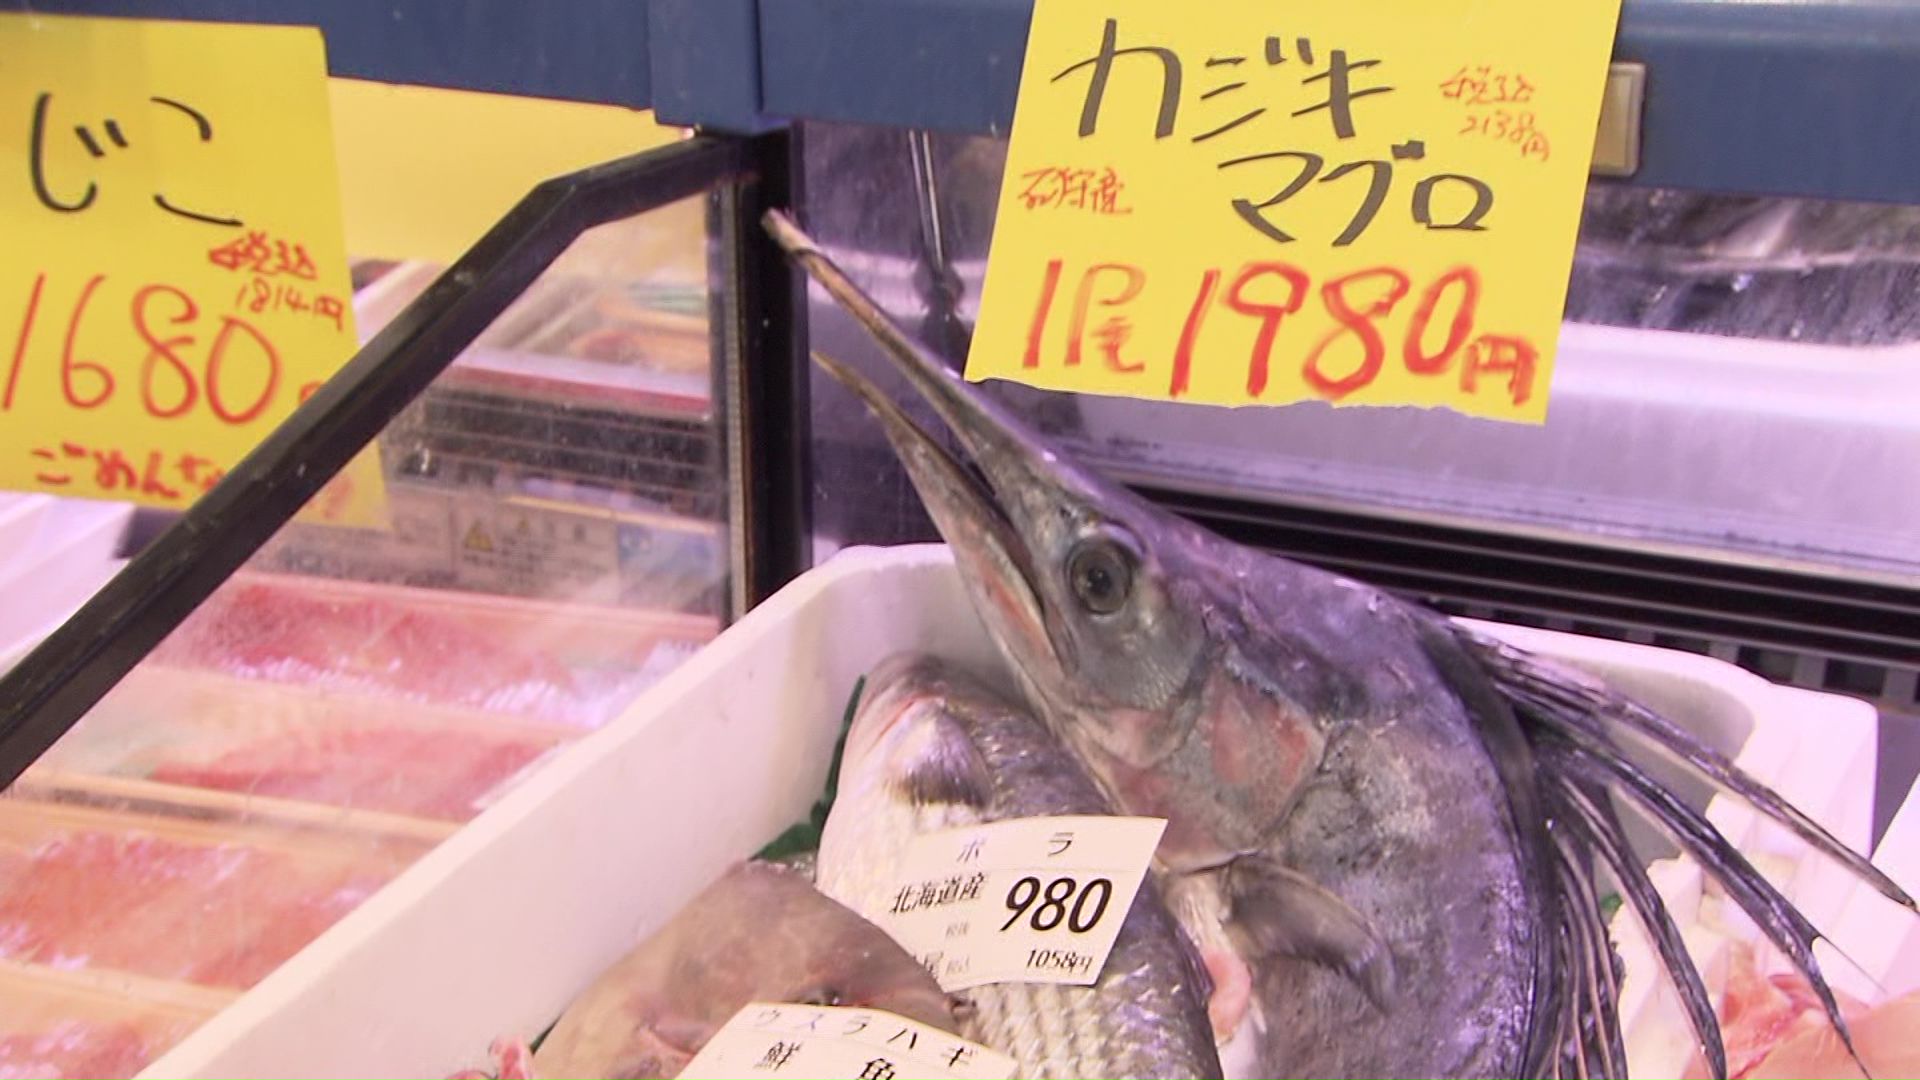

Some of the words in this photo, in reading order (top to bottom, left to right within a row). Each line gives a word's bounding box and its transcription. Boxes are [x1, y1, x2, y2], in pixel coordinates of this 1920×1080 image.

[1051, 19, 1393, 142] カジキ
[1457, 109, 1550, 162] 2138円
[1217, 138, 1495, 248] マグロ
[234, 276, 344, 331] 1814円
[1, 272, 324, 426] 1680
[1167, 260, 1540, 407] 1980円
[888, 871, 986, 915] 北海道産
[1000, 875, 1113, 934] 980
[1025, 949, 1093, 974] 1058円
